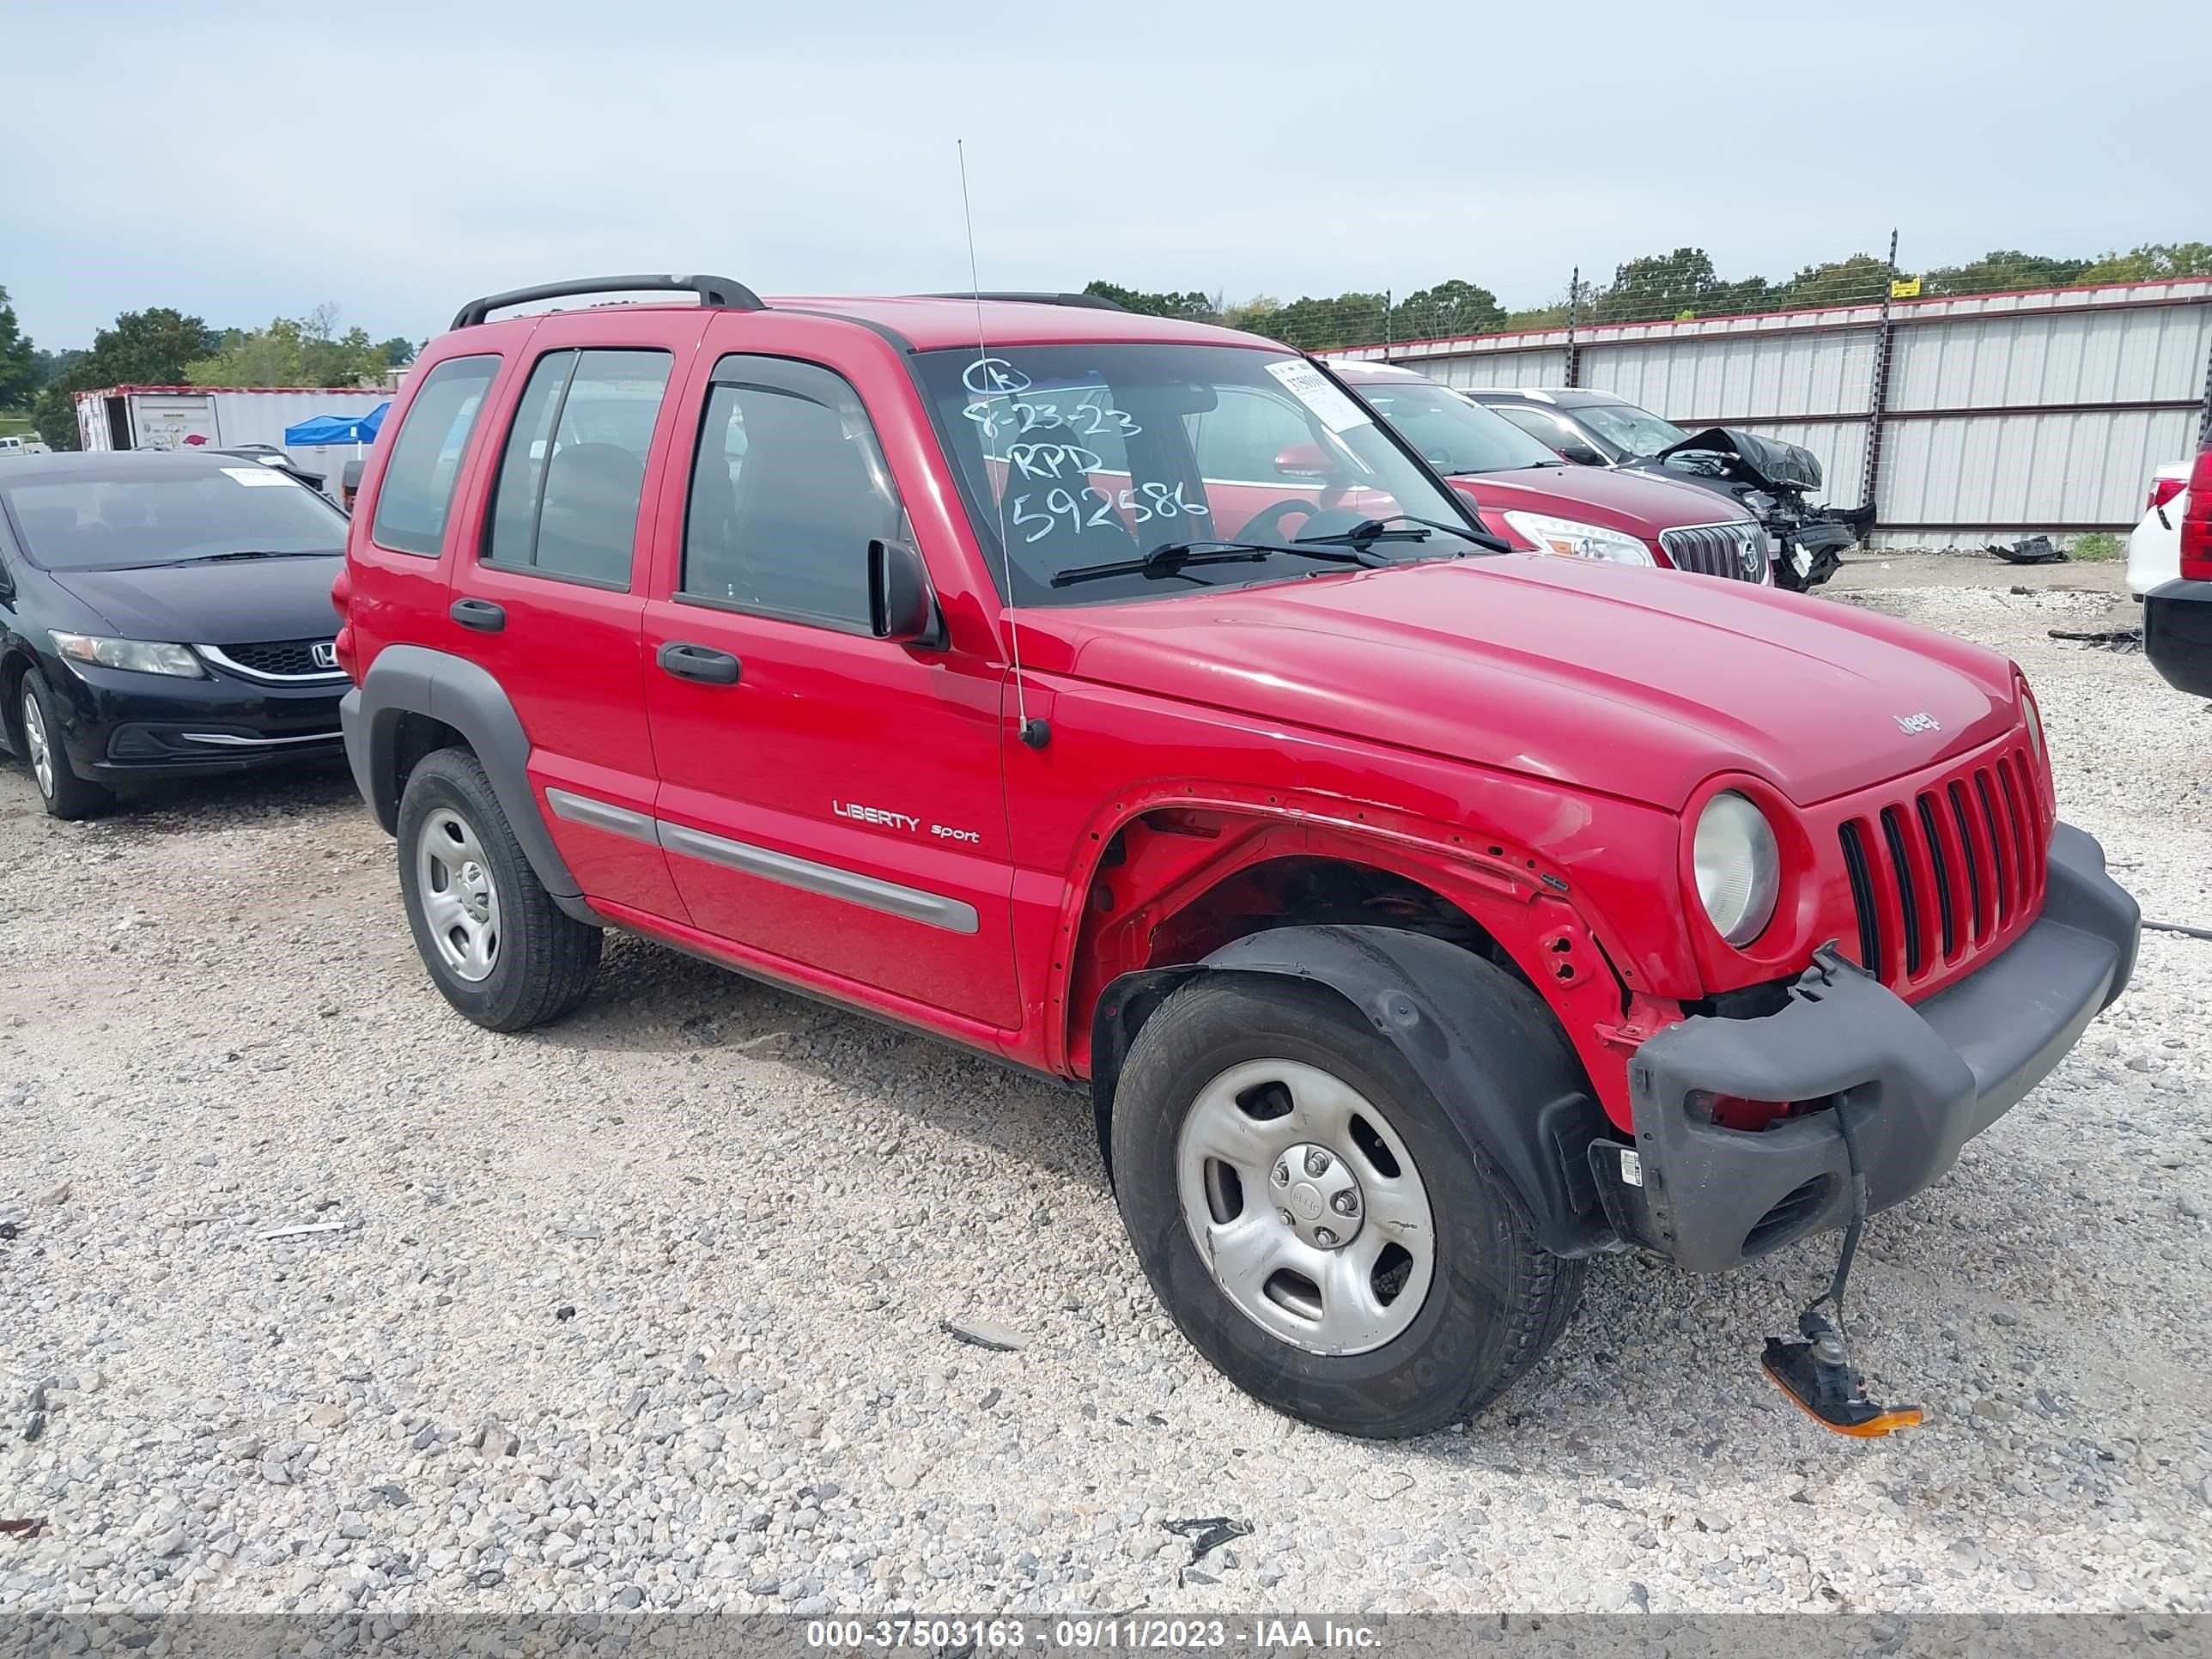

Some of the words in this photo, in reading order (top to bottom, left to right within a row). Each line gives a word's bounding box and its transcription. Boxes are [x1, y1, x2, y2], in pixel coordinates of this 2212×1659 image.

[962, 402, 1142, 438] 8-23-23
[1006, 443, 1103, 480] RPD
[1013, 481, 1209, 543] 592586
[1892, 714, 1942, 736] Jeep
[832, 799, 921, 832] LIBERTY
[931, 824, 980, 843] sport
